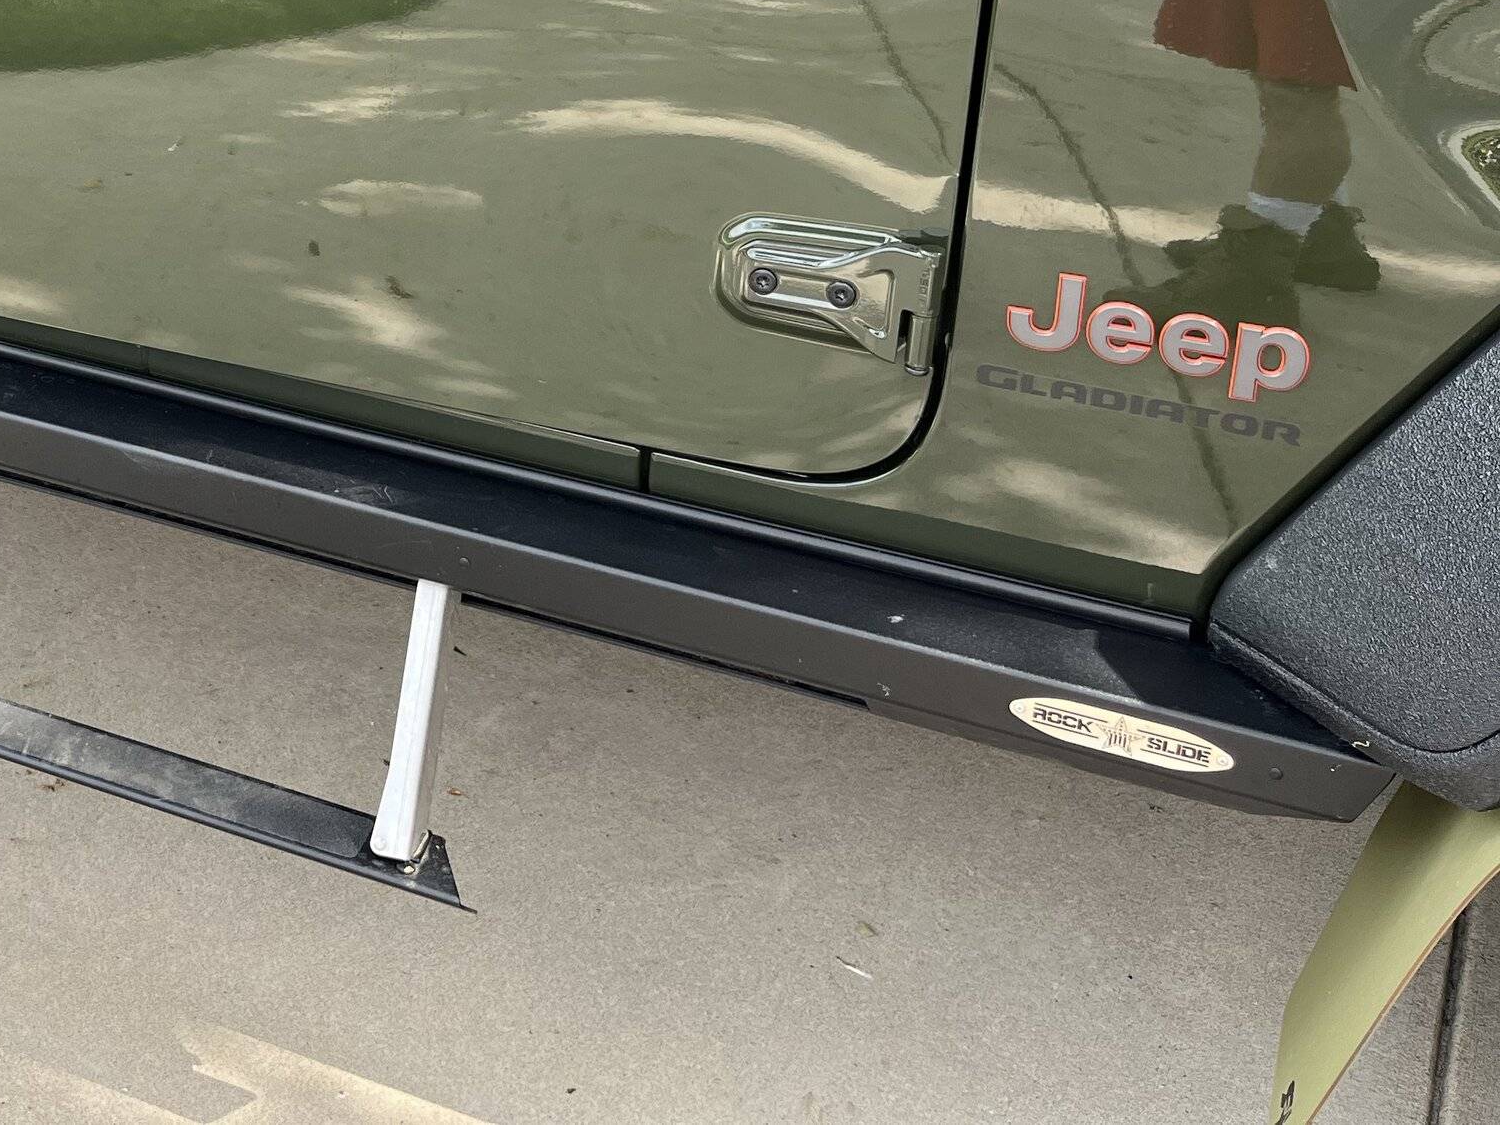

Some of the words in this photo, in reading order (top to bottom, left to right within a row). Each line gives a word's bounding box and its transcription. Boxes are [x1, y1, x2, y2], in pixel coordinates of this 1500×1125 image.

[1006, 272, 1311, 402] Jeep
[975, 364, 1301, 447] GLADIATOR
[1033, 707, 1094, 734] ROCK
[1147, 736, 1212, 764] SLIDE
